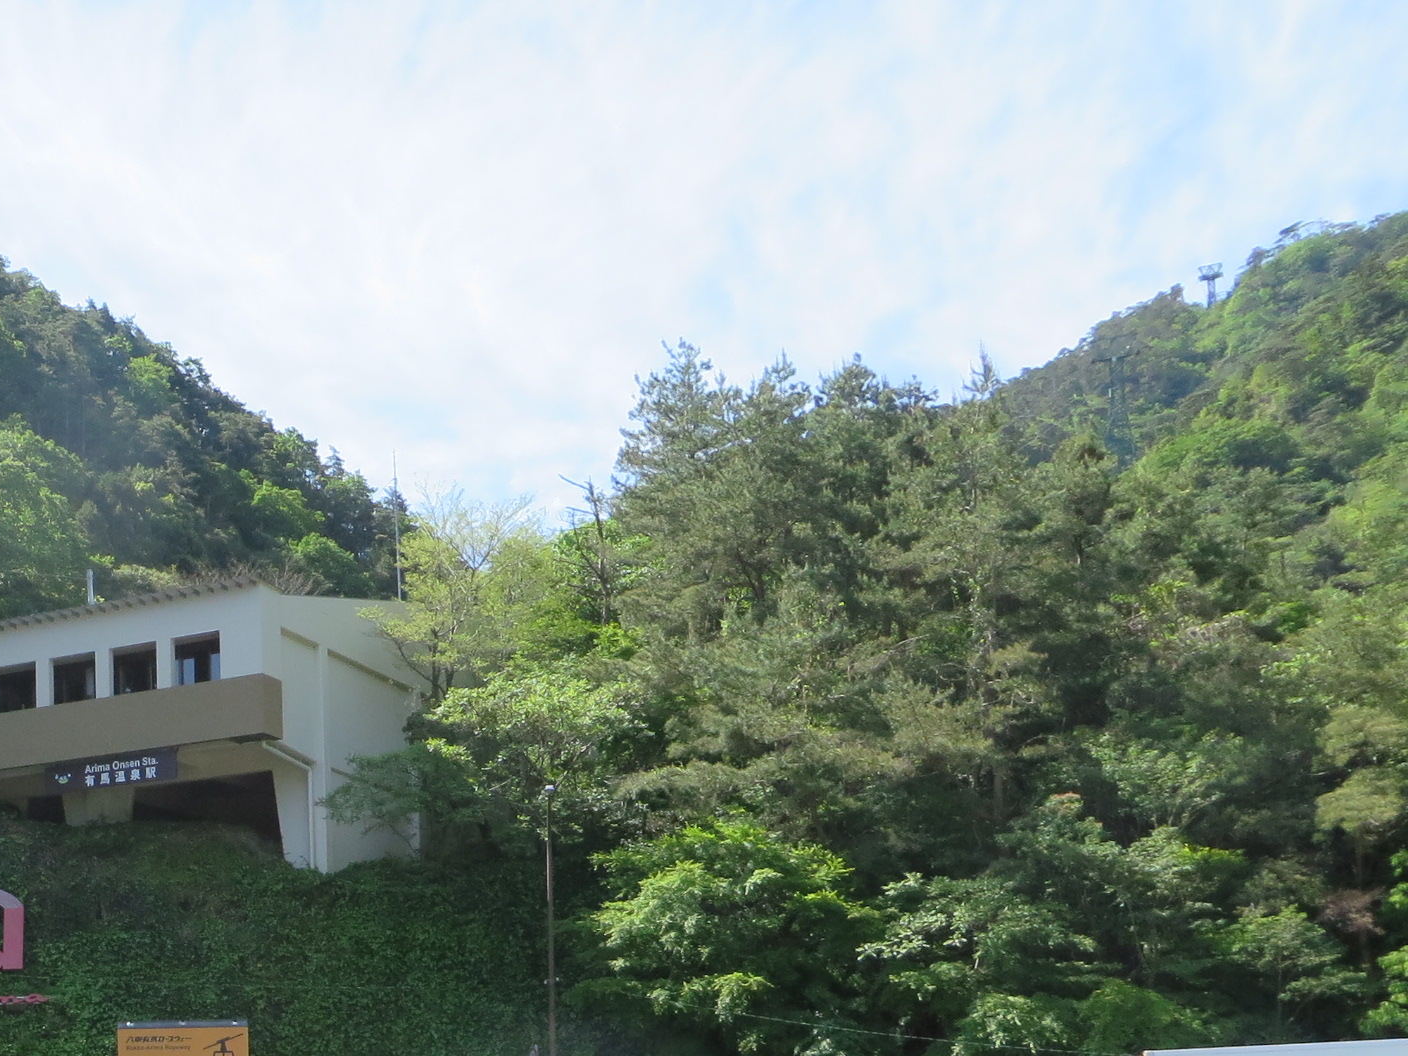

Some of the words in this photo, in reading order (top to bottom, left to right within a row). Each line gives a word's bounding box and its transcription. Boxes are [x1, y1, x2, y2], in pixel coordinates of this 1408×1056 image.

[85, 763, 110, 774] Arima
[112, 759, 140, 771] Onsen
[142, 757, 158, 766] Sta.
[85, 767, 156, 787] 有馬温泉駅
